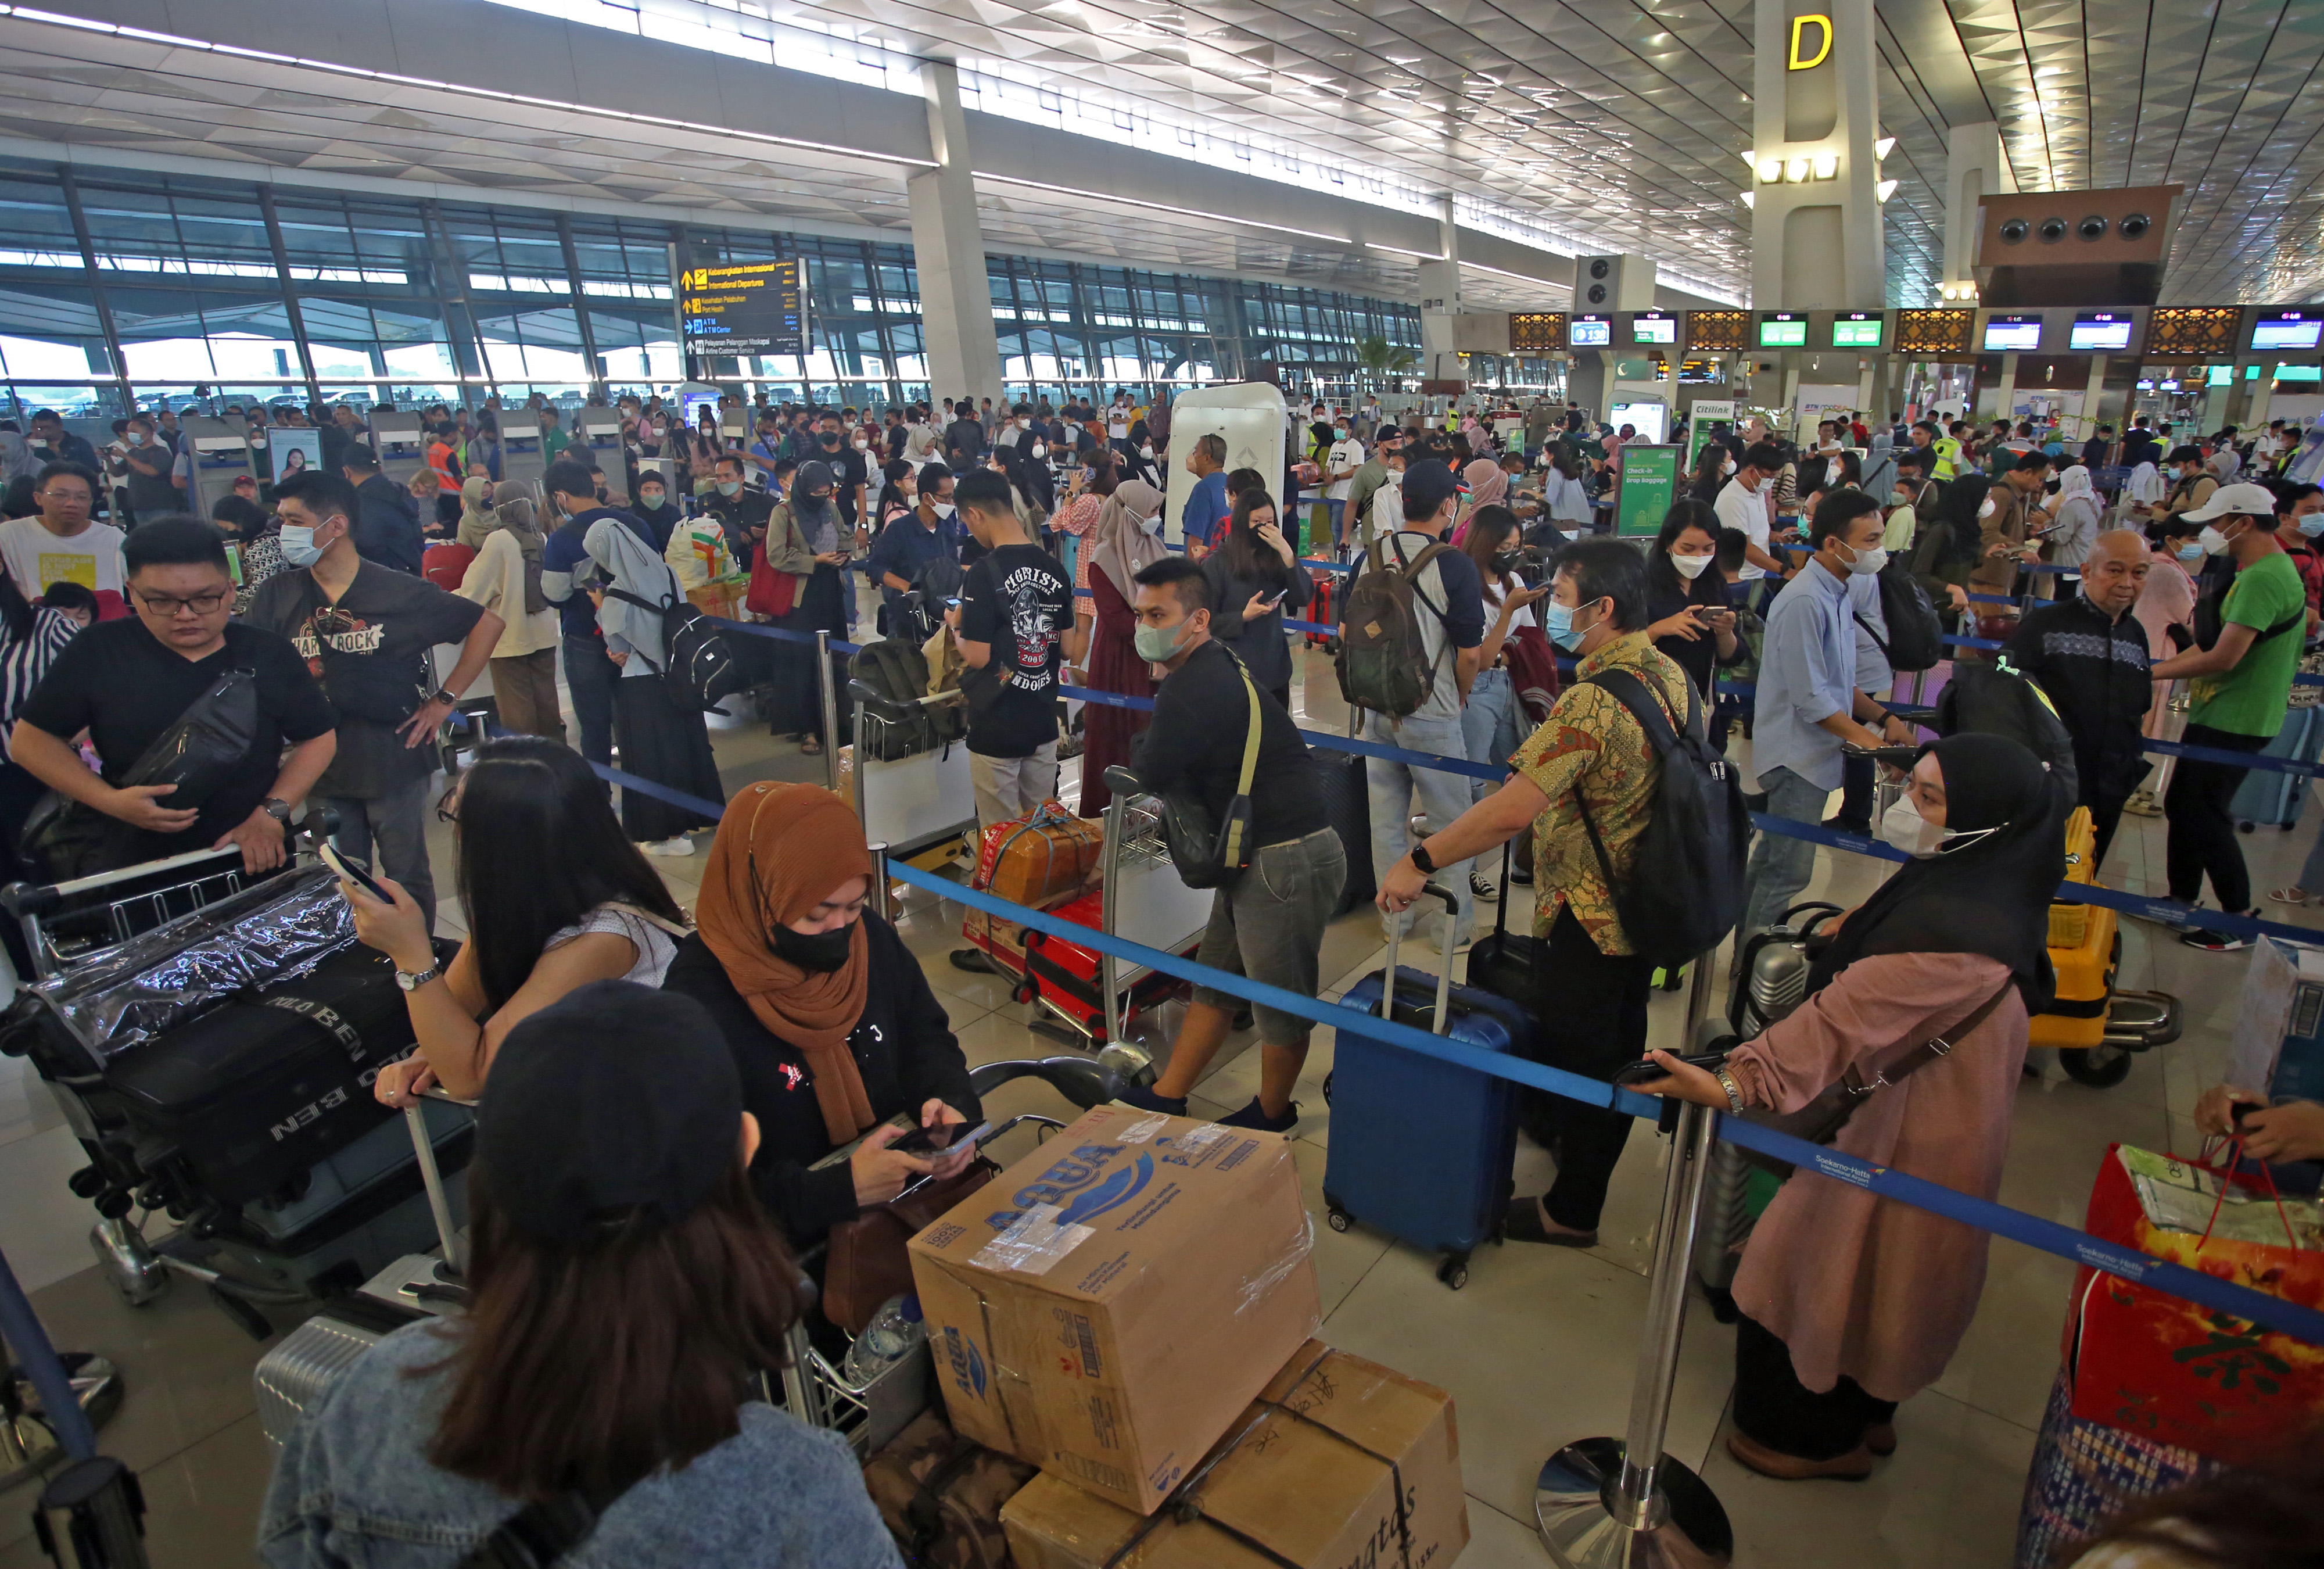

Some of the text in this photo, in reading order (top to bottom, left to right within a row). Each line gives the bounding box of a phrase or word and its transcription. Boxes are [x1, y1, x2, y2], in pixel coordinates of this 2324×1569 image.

[1788, 15, 1832, 70] D
[708, 266, 743, 277] Keberangkatan
[744, 263, 775, 273] Internasional
[708, 279, 764, 289] International Departures
[749, 338, 770, 346] Maskapai
[1587, 329, 1606, 341] 138
[1697, 406, 1729, 414] Citilink
[338, 631, 378, 651] ROCK
[312, 1006, 367, 1062] BEN
[1816, 1155, 1870, 1178] Soekarno-Hatta
[1820, 1163, 1850, 1177] International
[1851, 1174, 1869, 1184] Airport
[984, 1144, 1127, 1238] AQUA
[1115, 1182, 1177, 1231] Terlindungi untuk
[1131, 1189, 1181, 1230] Melindungimu
[927, 1224, 957, 1245] 100%
